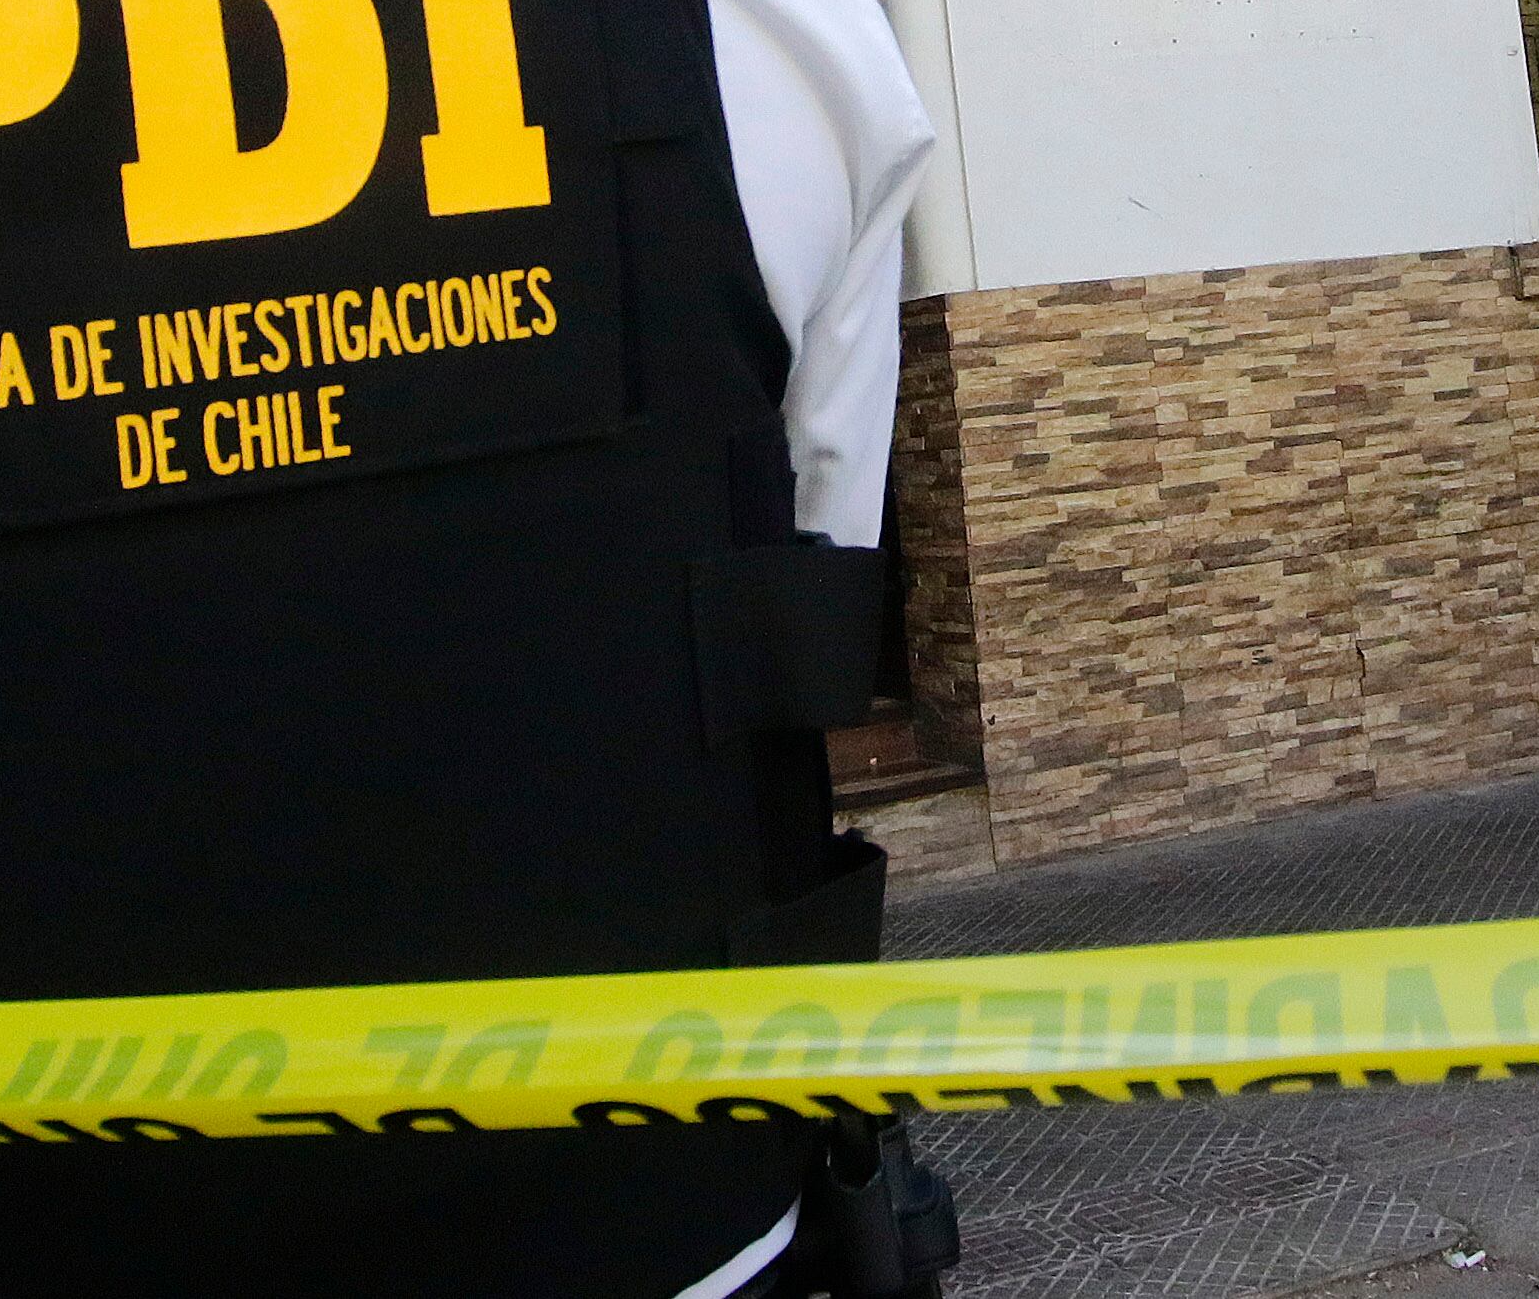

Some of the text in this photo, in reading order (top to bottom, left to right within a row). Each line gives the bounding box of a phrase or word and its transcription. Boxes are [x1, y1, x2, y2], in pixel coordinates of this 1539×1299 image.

[49, 319, 125, 403] DE
[139, 267, 558, 392] INVESTIGACIONES
[116, 385, 351, 491] DE CHILE
